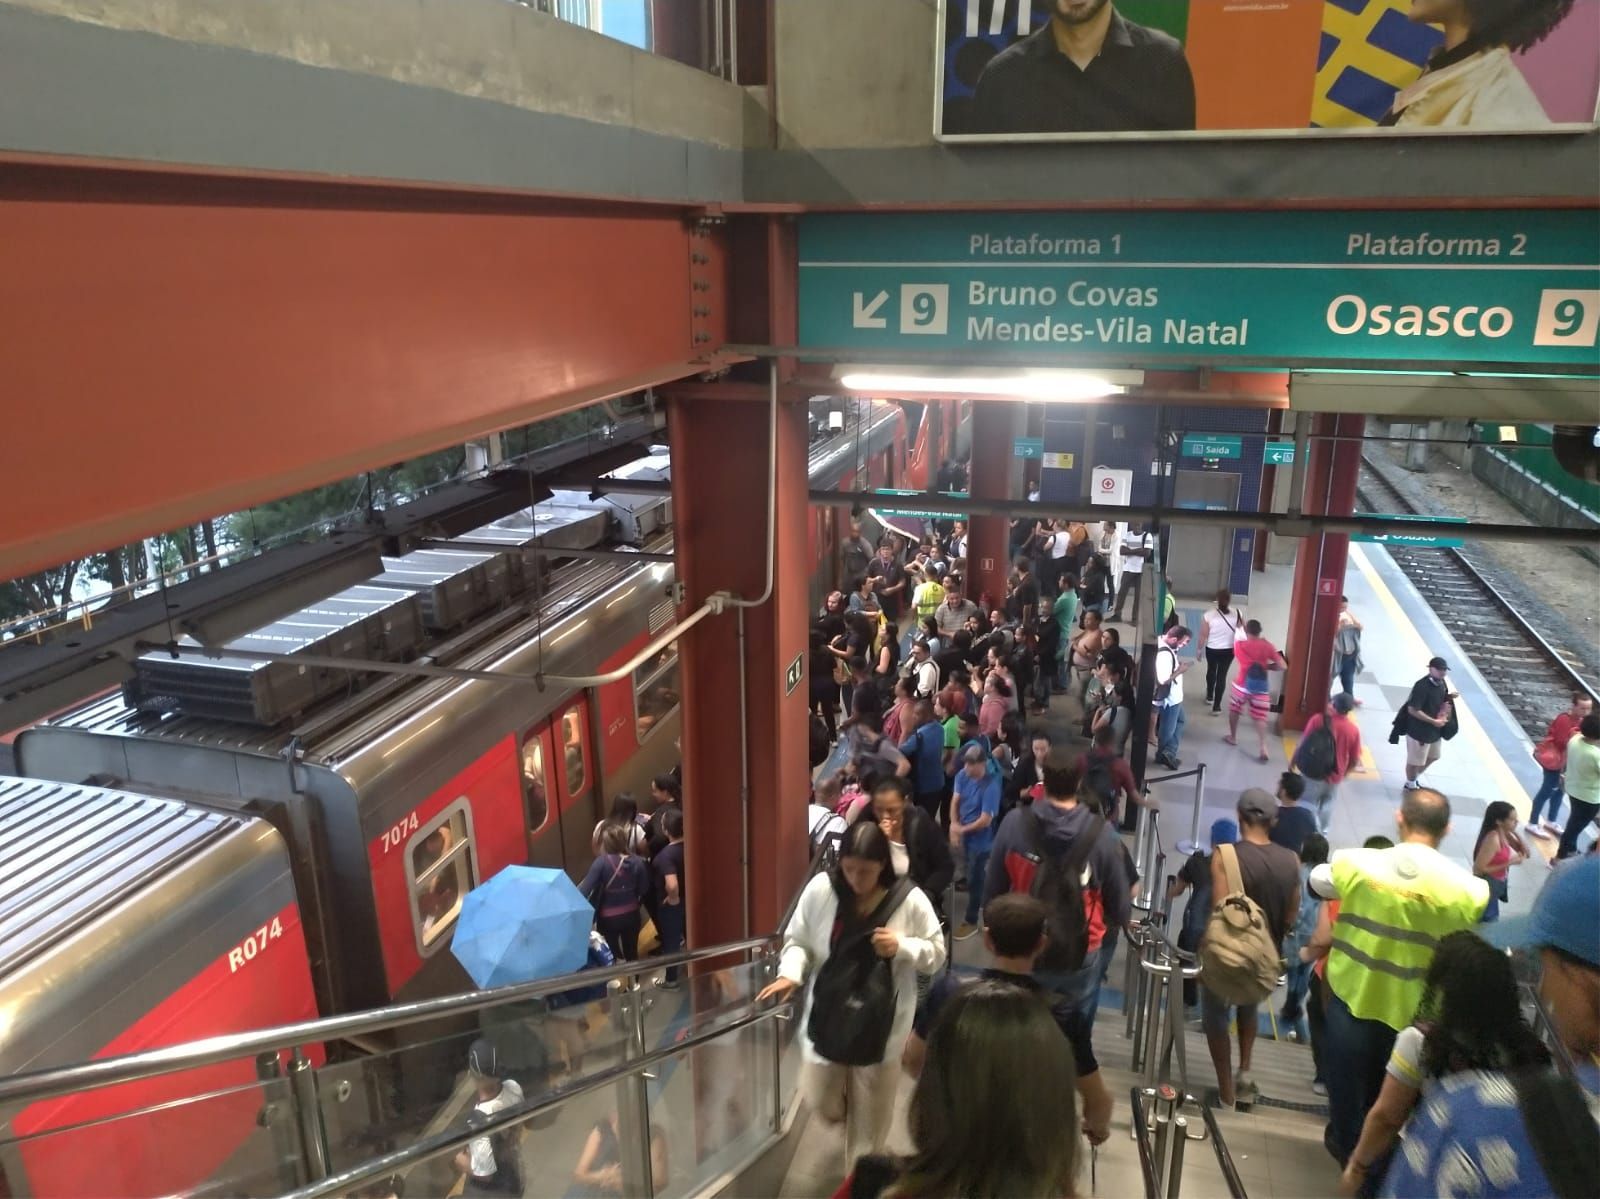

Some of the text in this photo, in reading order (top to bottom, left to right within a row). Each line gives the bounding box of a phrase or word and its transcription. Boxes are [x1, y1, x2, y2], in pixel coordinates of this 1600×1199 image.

[970, 233, 1122, 255] Plataforma 1
[1346, 232, 1527, 256] Plataforma 2
[912, 292, 937, 326] 9
[969, 281, 1158, 307] Bruno Covas
[966, 316, 1248, 346] Mendes-Vila Natal
[1326, 294, 1514, 338] Osasco
[1552, 298, 1585, 337] 9
[381, 811, 419, 854] 7074
[228, 917, 283, 973] R074
